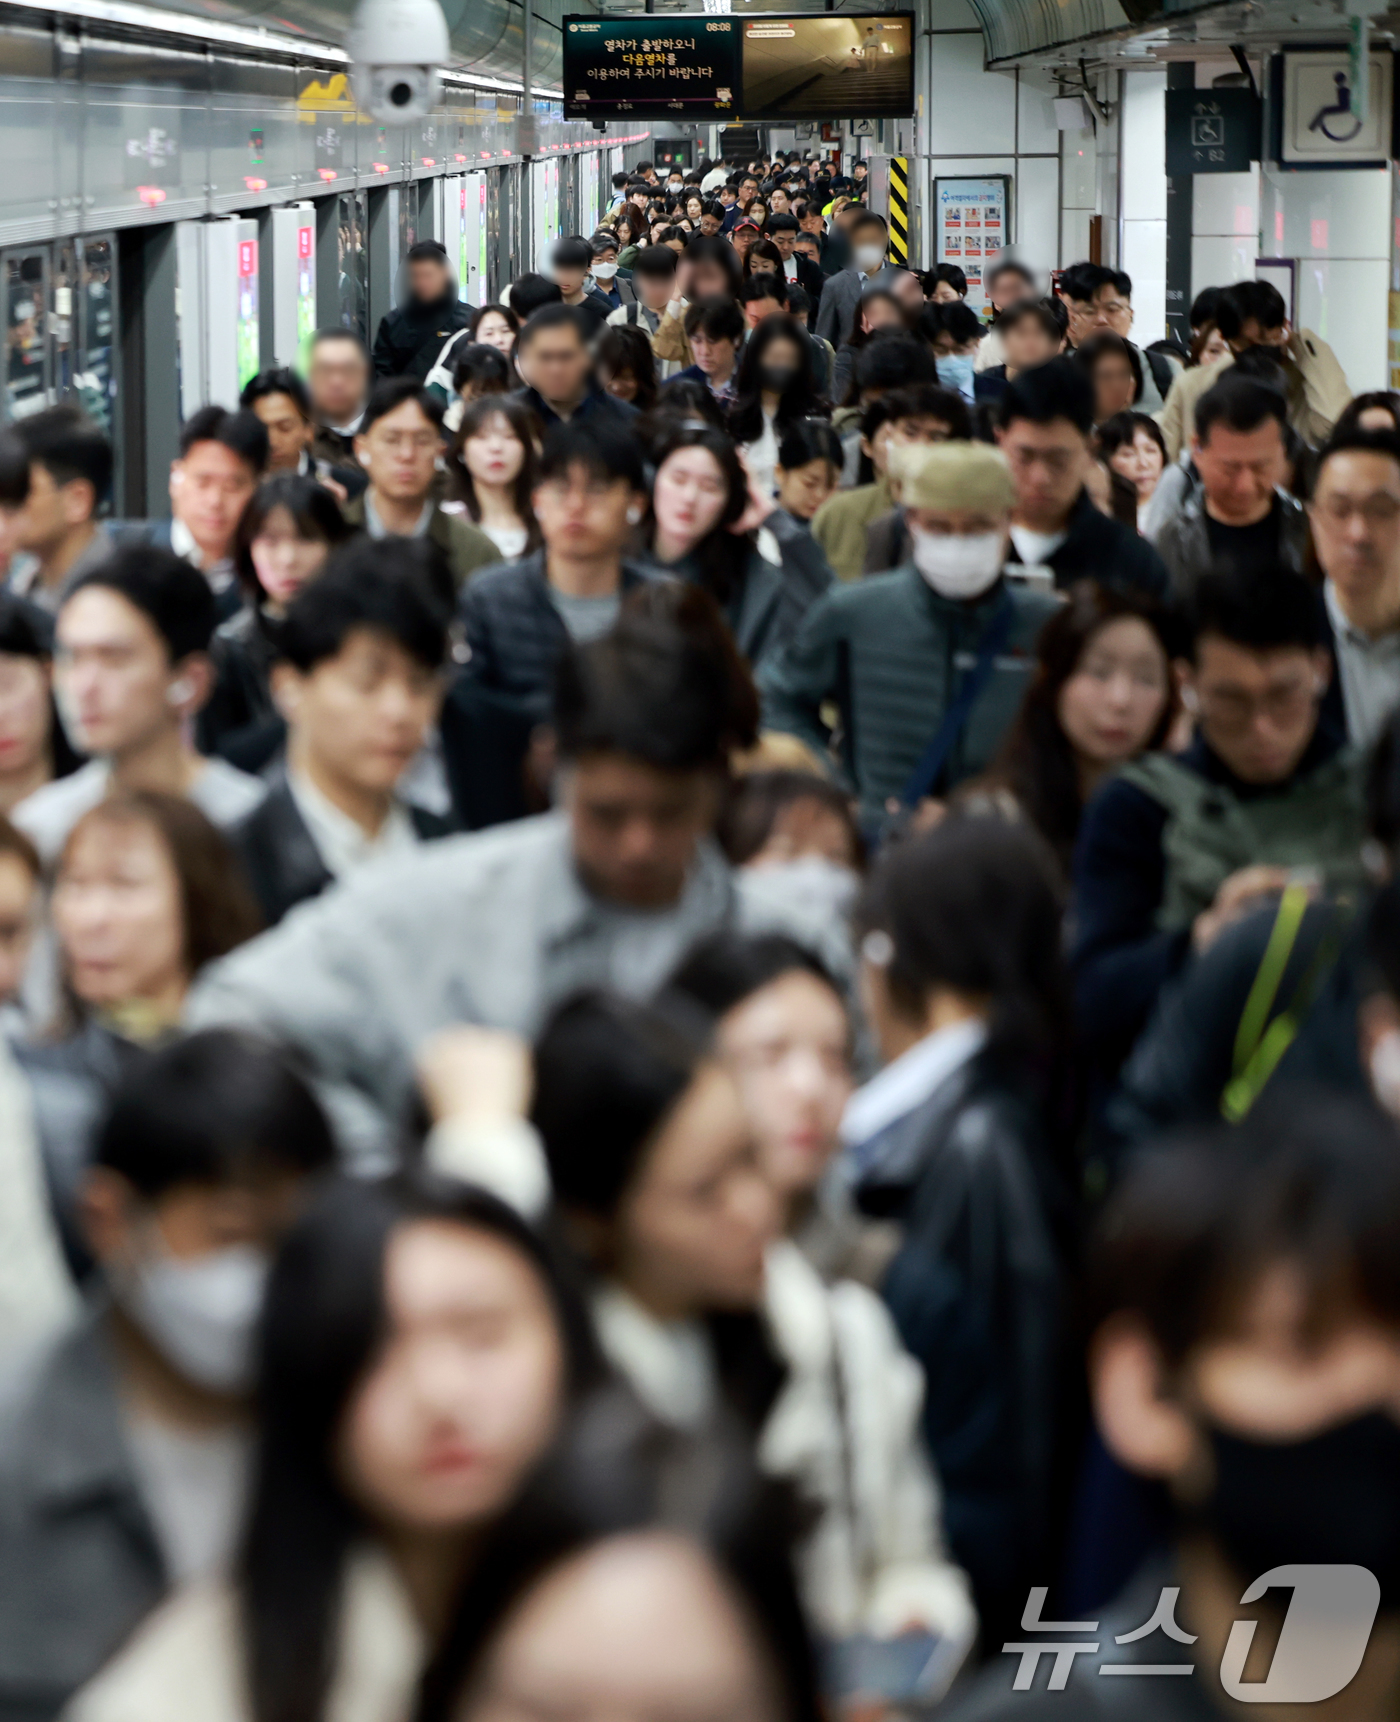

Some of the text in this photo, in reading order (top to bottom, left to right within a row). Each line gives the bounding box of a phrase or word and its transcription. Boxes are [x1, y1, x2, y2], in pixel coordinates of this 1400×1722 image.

[706, 22, 732, 32] 08:08
[604, 38, 695, 52] 열차가 출발하오니
[622, 53, 677, 66] 다음열차를
[587, 67, 713, 81] 이용하여 주시기 바랍니다
[1208, 148, 1225, 162] B2
